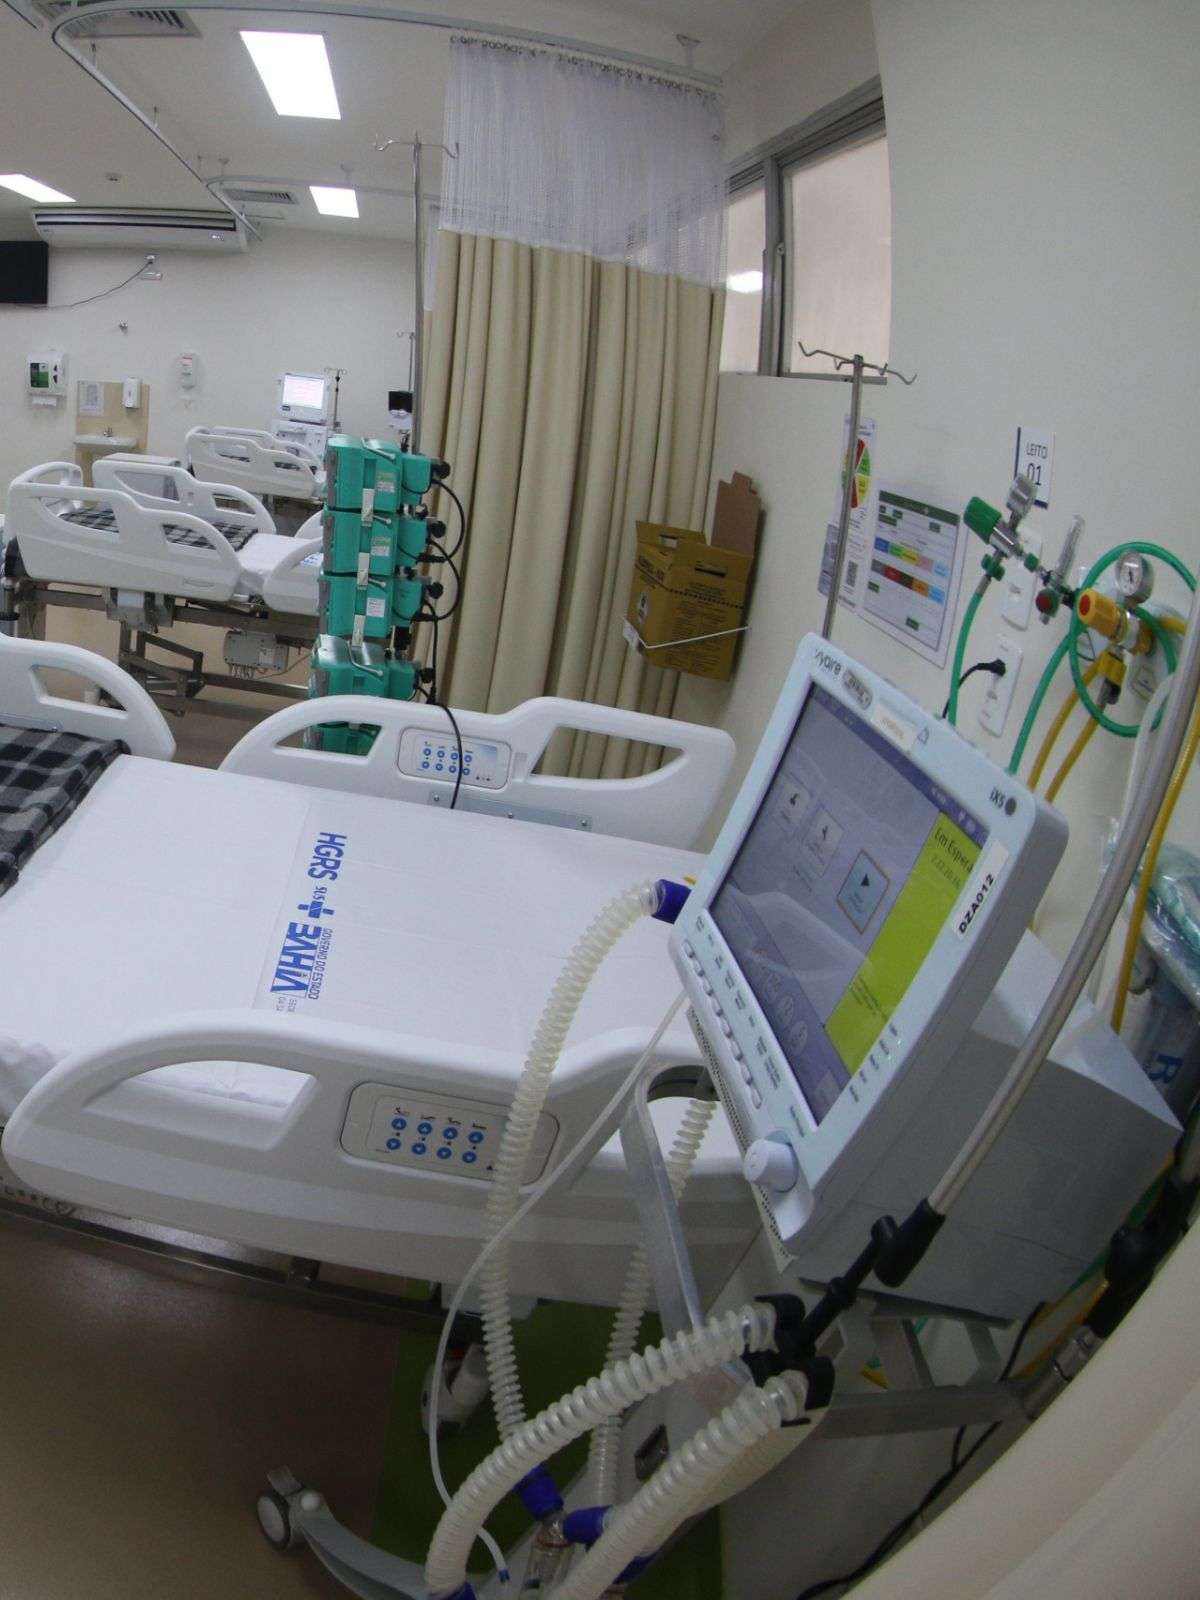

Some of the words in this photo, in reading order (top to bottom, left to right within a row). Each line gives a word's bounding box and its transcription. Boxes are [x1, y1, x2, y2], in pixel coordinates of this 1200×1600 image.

[1026, 442, 1048, 460] LEITO
[1027, 462, 1042, 486] 01
[307, 831, 348, 881] HGRS
[958, 873, 994, 934] DZA012
[270, 921, 323, 993] BAHIA
[308, 973, 324, 1000] ESTADO
